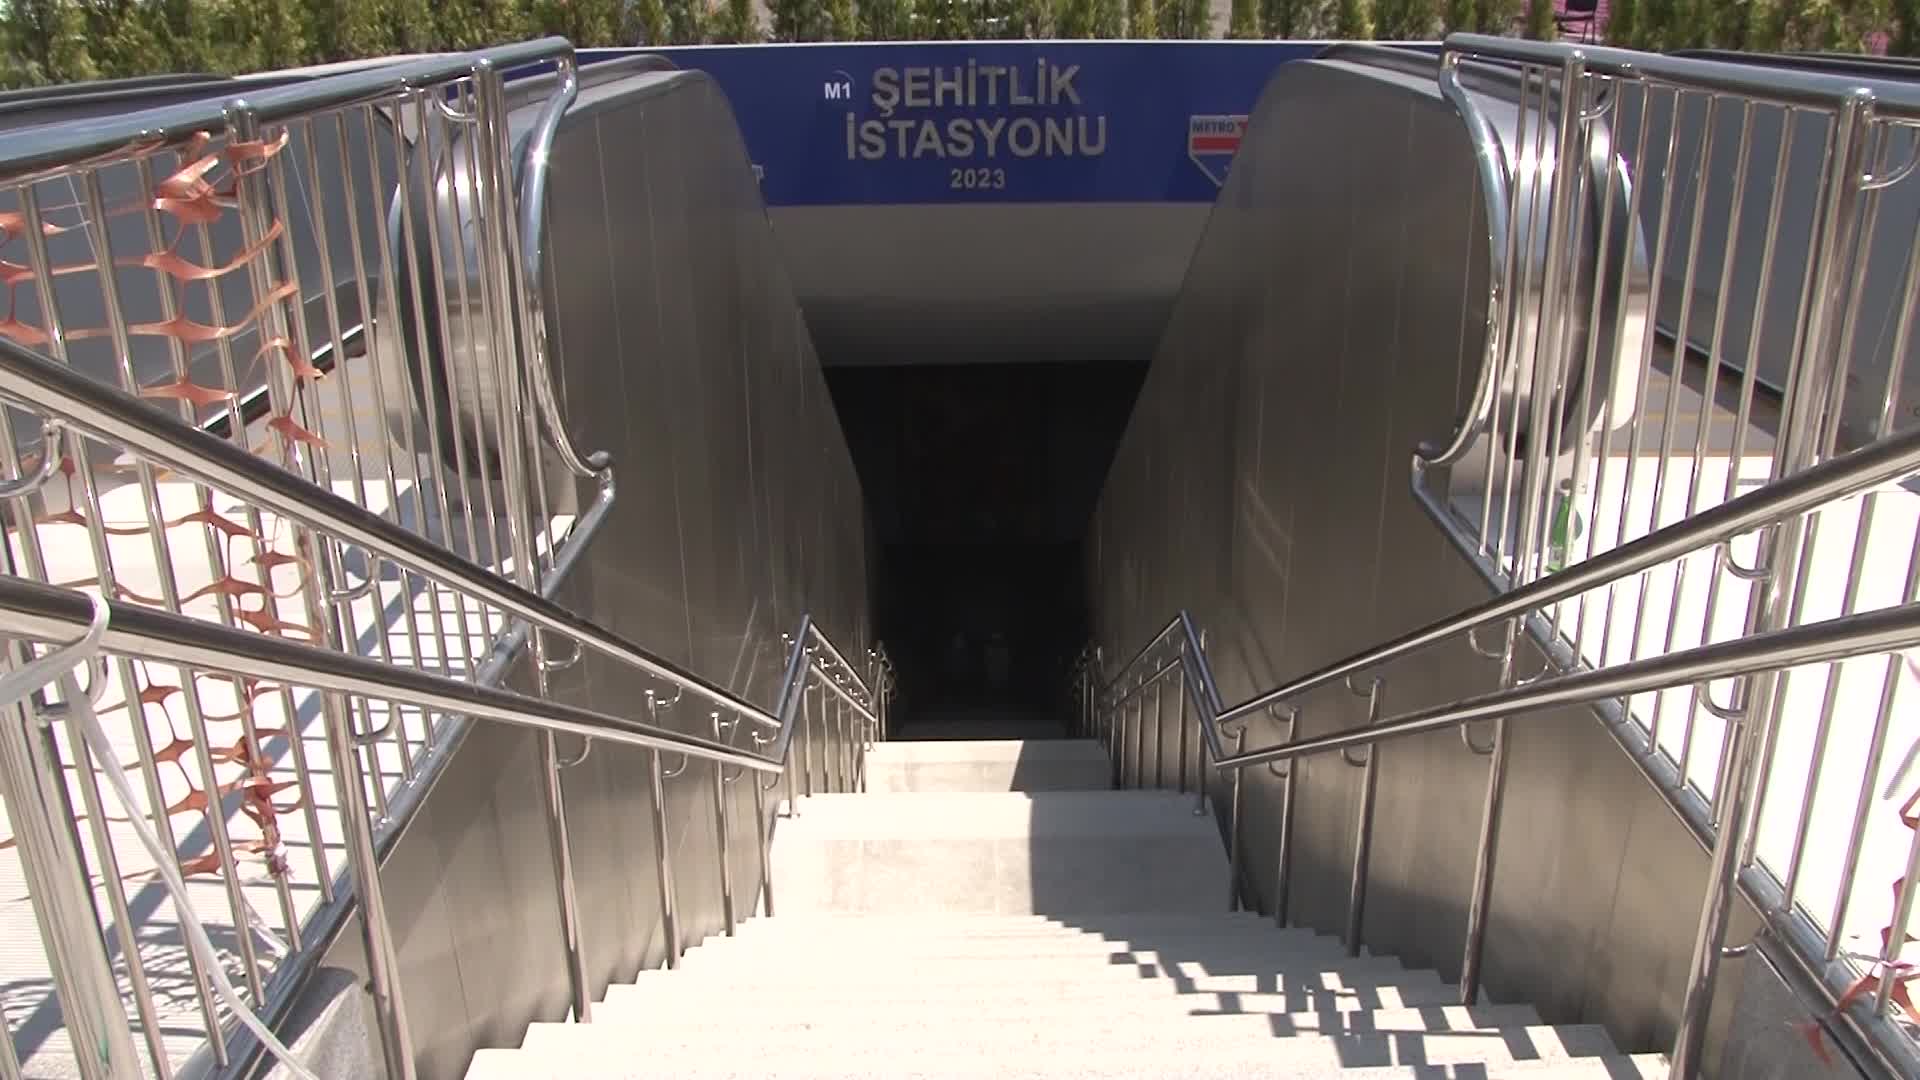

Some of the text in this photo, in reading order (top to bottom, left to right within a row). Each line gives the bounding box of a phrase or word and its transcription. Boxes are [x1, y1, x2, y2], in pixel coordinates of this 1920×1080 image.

[824, 82, 850, 99] M1
[872, 58, 1081, 117] ŞEHİTLİK
[847, 112, 1106, 160] İSTASYONU
[951, 168, 1005, 189] 2023
